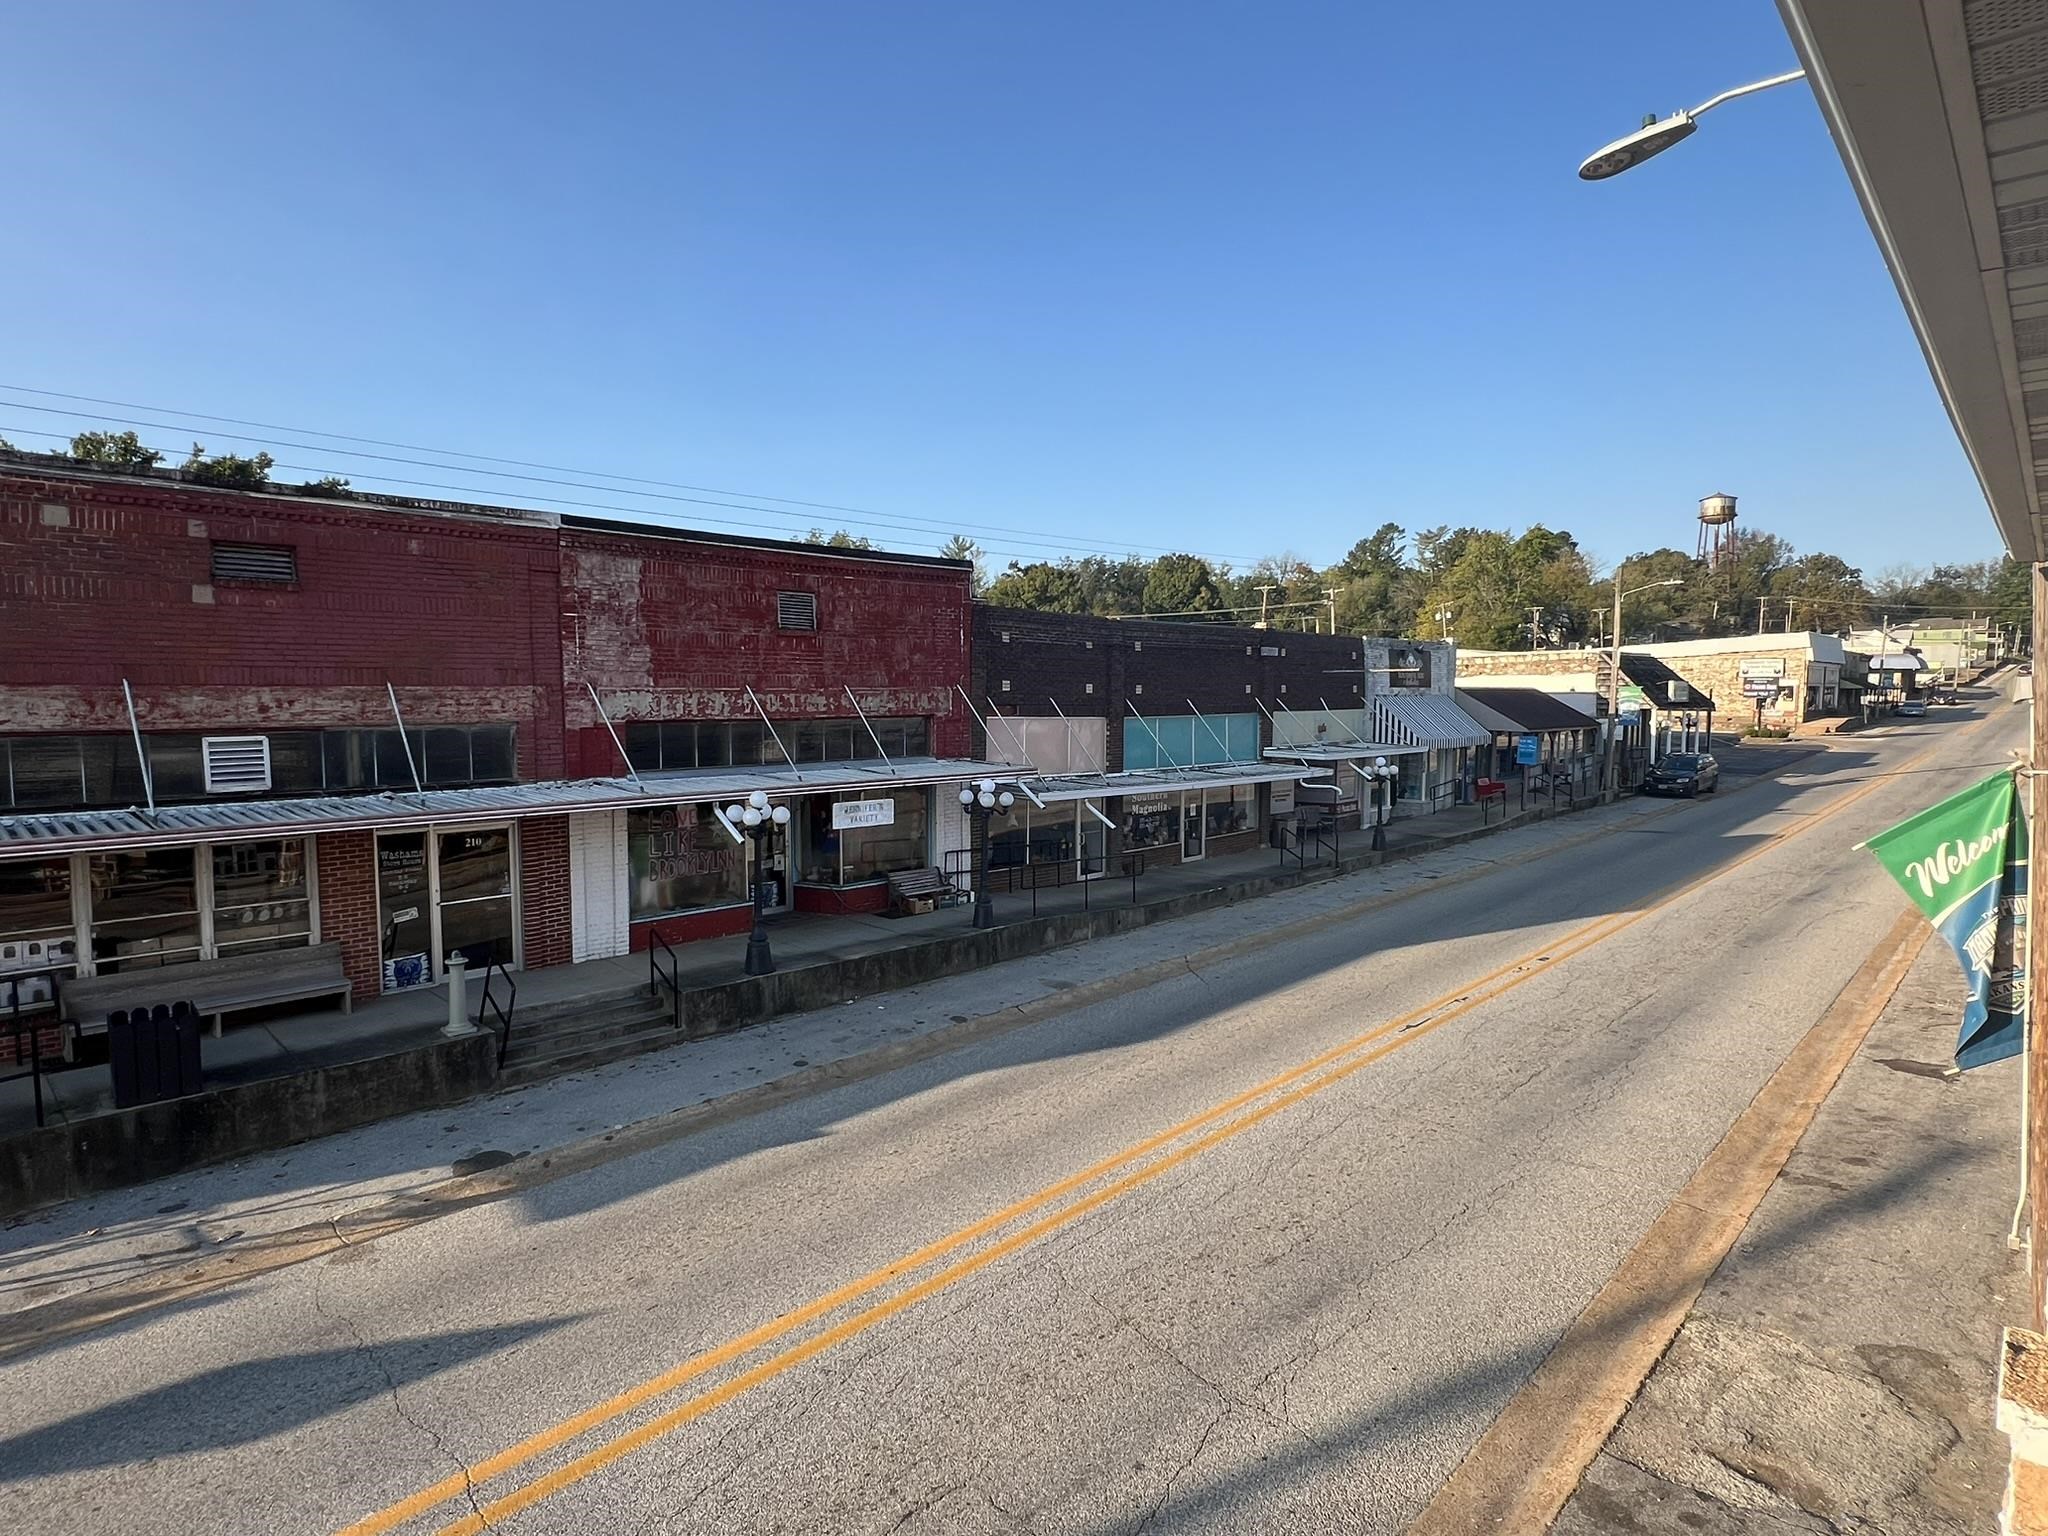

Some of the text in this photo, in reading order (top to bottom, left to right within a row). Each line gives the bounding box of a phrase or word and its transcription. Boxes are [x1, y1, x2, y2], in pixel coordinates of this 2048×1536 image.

[648, 808, 698, 832] LOVE
[1131, 801, 1168, 816] Magnolia
[465, 837, 482, 848] 210
[648, 828, 698, 858] LIKE
[1904, 822, 2010, 898] Welcom
